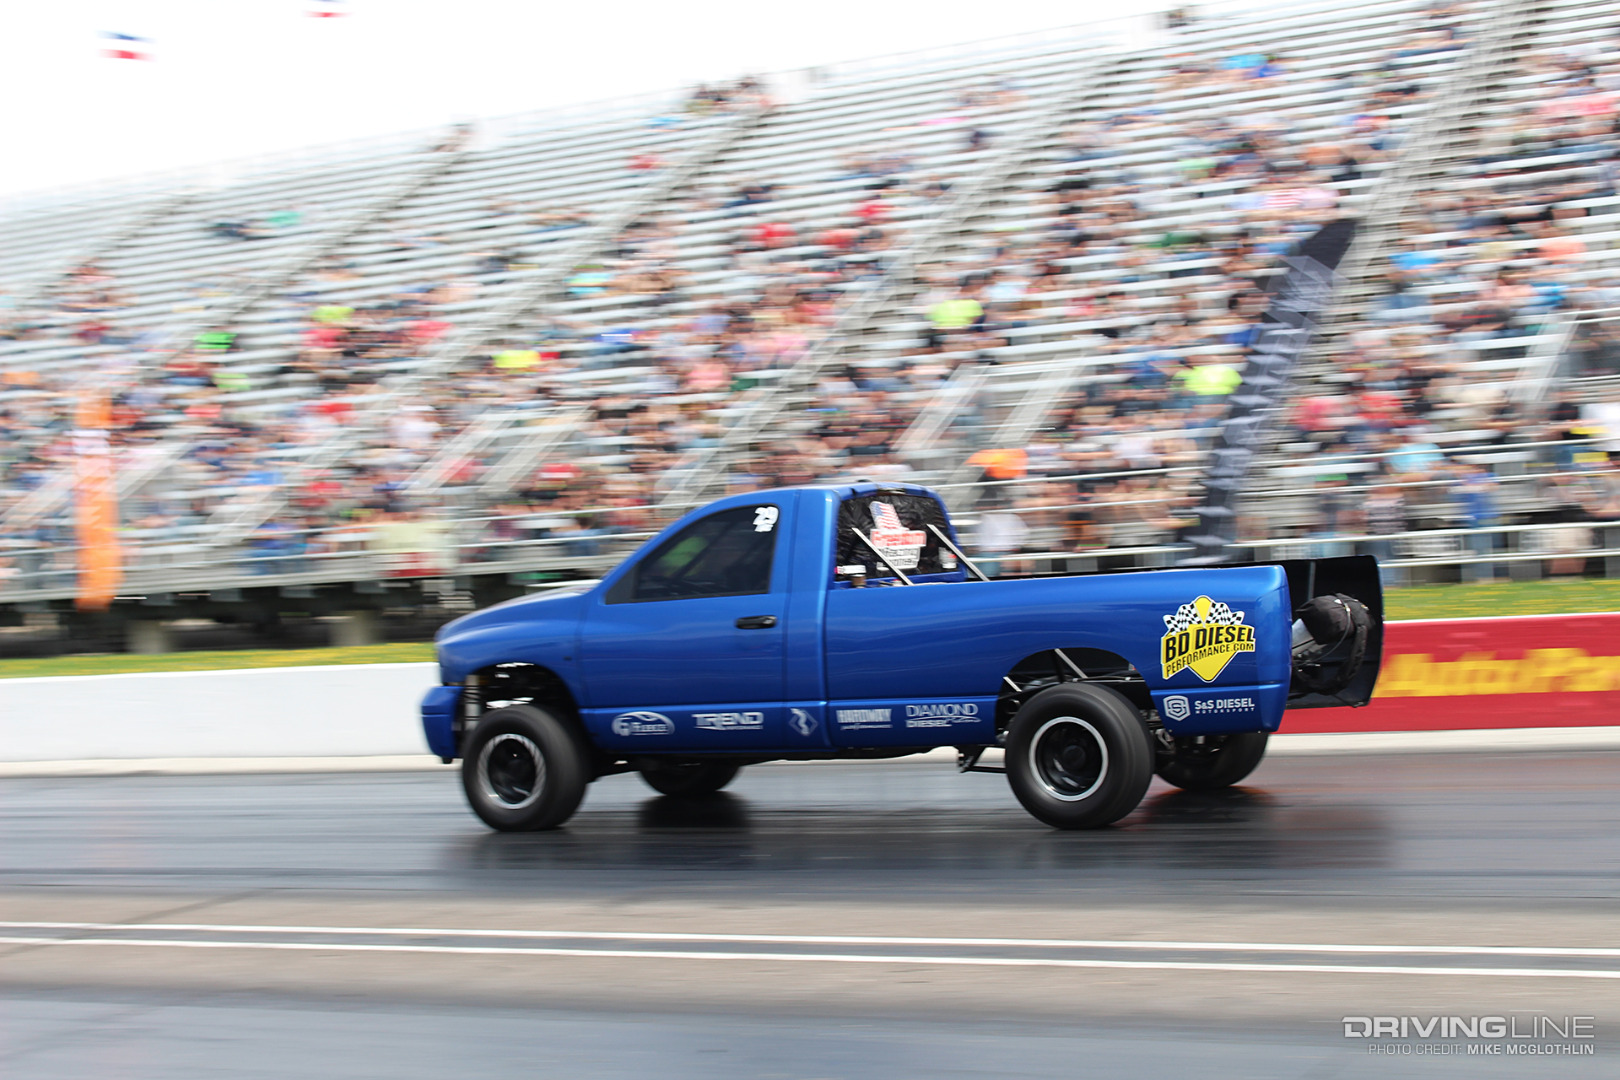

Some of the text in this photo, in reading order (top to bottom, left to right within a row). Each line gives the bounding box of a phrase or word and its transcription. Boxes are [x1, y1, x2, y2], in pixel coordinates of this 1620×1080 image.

[753, 506, 779, 525] 29
[1165, 626, 1254, 664] BD DIESEL
[1166, 643, 1254, 677] PERFORMANCE.COM
[905, 703, 979, 717] DIAMOND
[1194, 698, 1255, 710] S&S DIESEL
[692, 712, 764, 726] TREND
